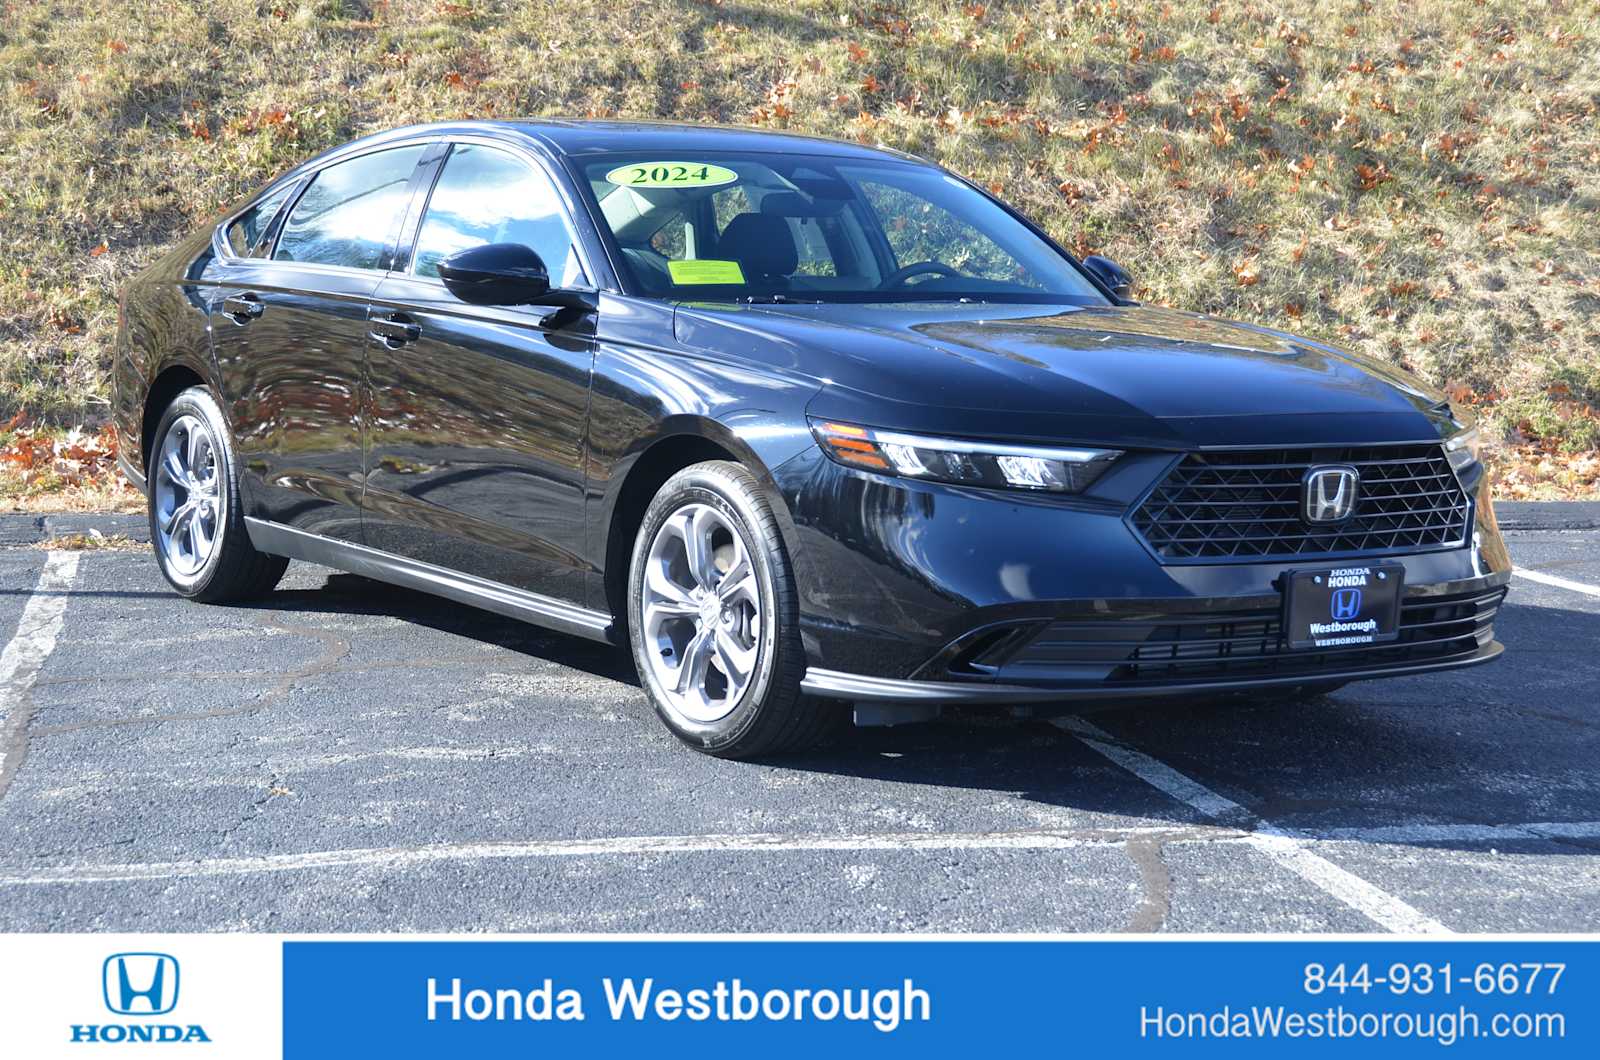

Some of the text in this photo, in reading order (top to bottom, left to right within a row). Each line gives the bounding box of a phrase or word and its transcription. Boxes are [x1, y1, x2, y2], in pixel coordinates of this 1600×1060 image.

[631, 166, 710, 184] 2024
[1330, 568, 1371, 577] HONDA
[1328, 576, 1367, 588] HONDA
[1310, 619, 1377, 634] Westborough
[1315, 635, 1373, 647] WESTBOROUGH
